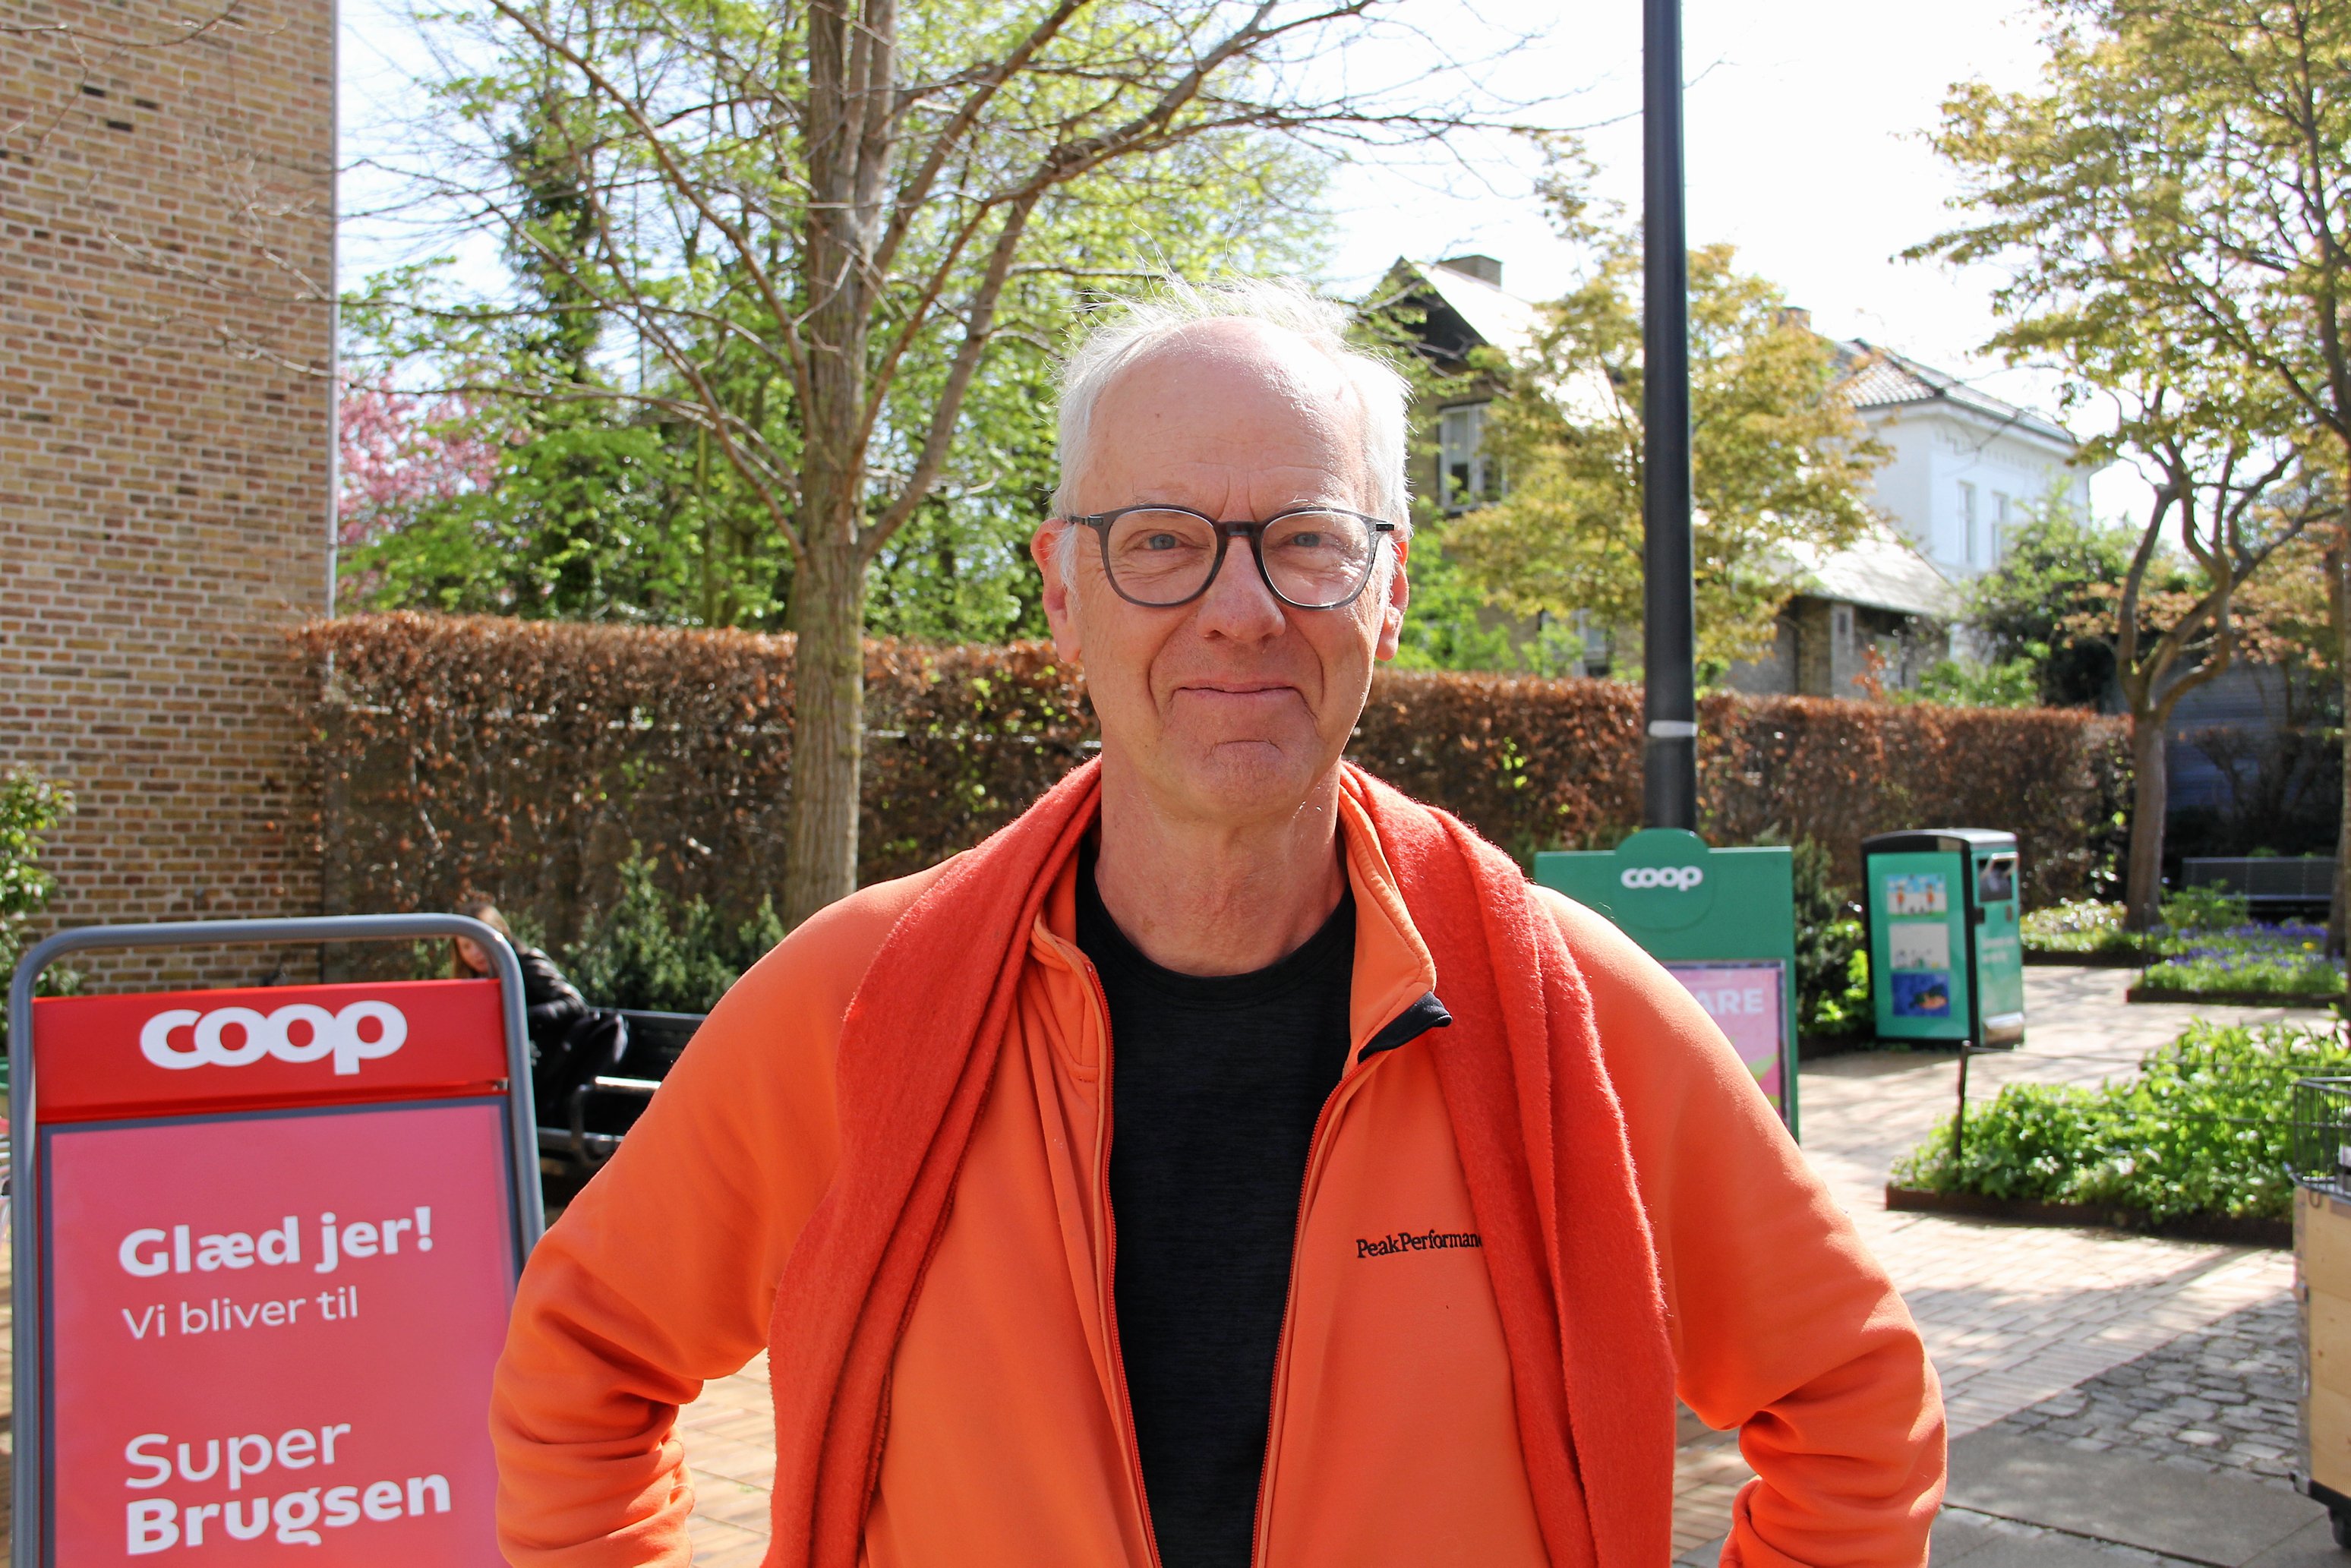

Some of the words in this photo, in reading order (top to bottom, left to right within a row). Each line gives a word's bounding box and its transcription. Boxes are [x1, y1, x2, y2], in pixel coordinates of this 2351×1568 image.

[1620, 866, 1703, 891] coop
[140, 1000, 408, 1075] coop
[118, 1216, 301, 1277] Glæd
[314, 1207, 433, 1273] jer!
[122, 1305, 166, 1339] Vi
[180, 1298, 306, 1334] bliver
[316, 1286, 358, 1320] til
[125, 1423, 352, 1490] Super
[126, 1473, 451, 1555] Brugsen
